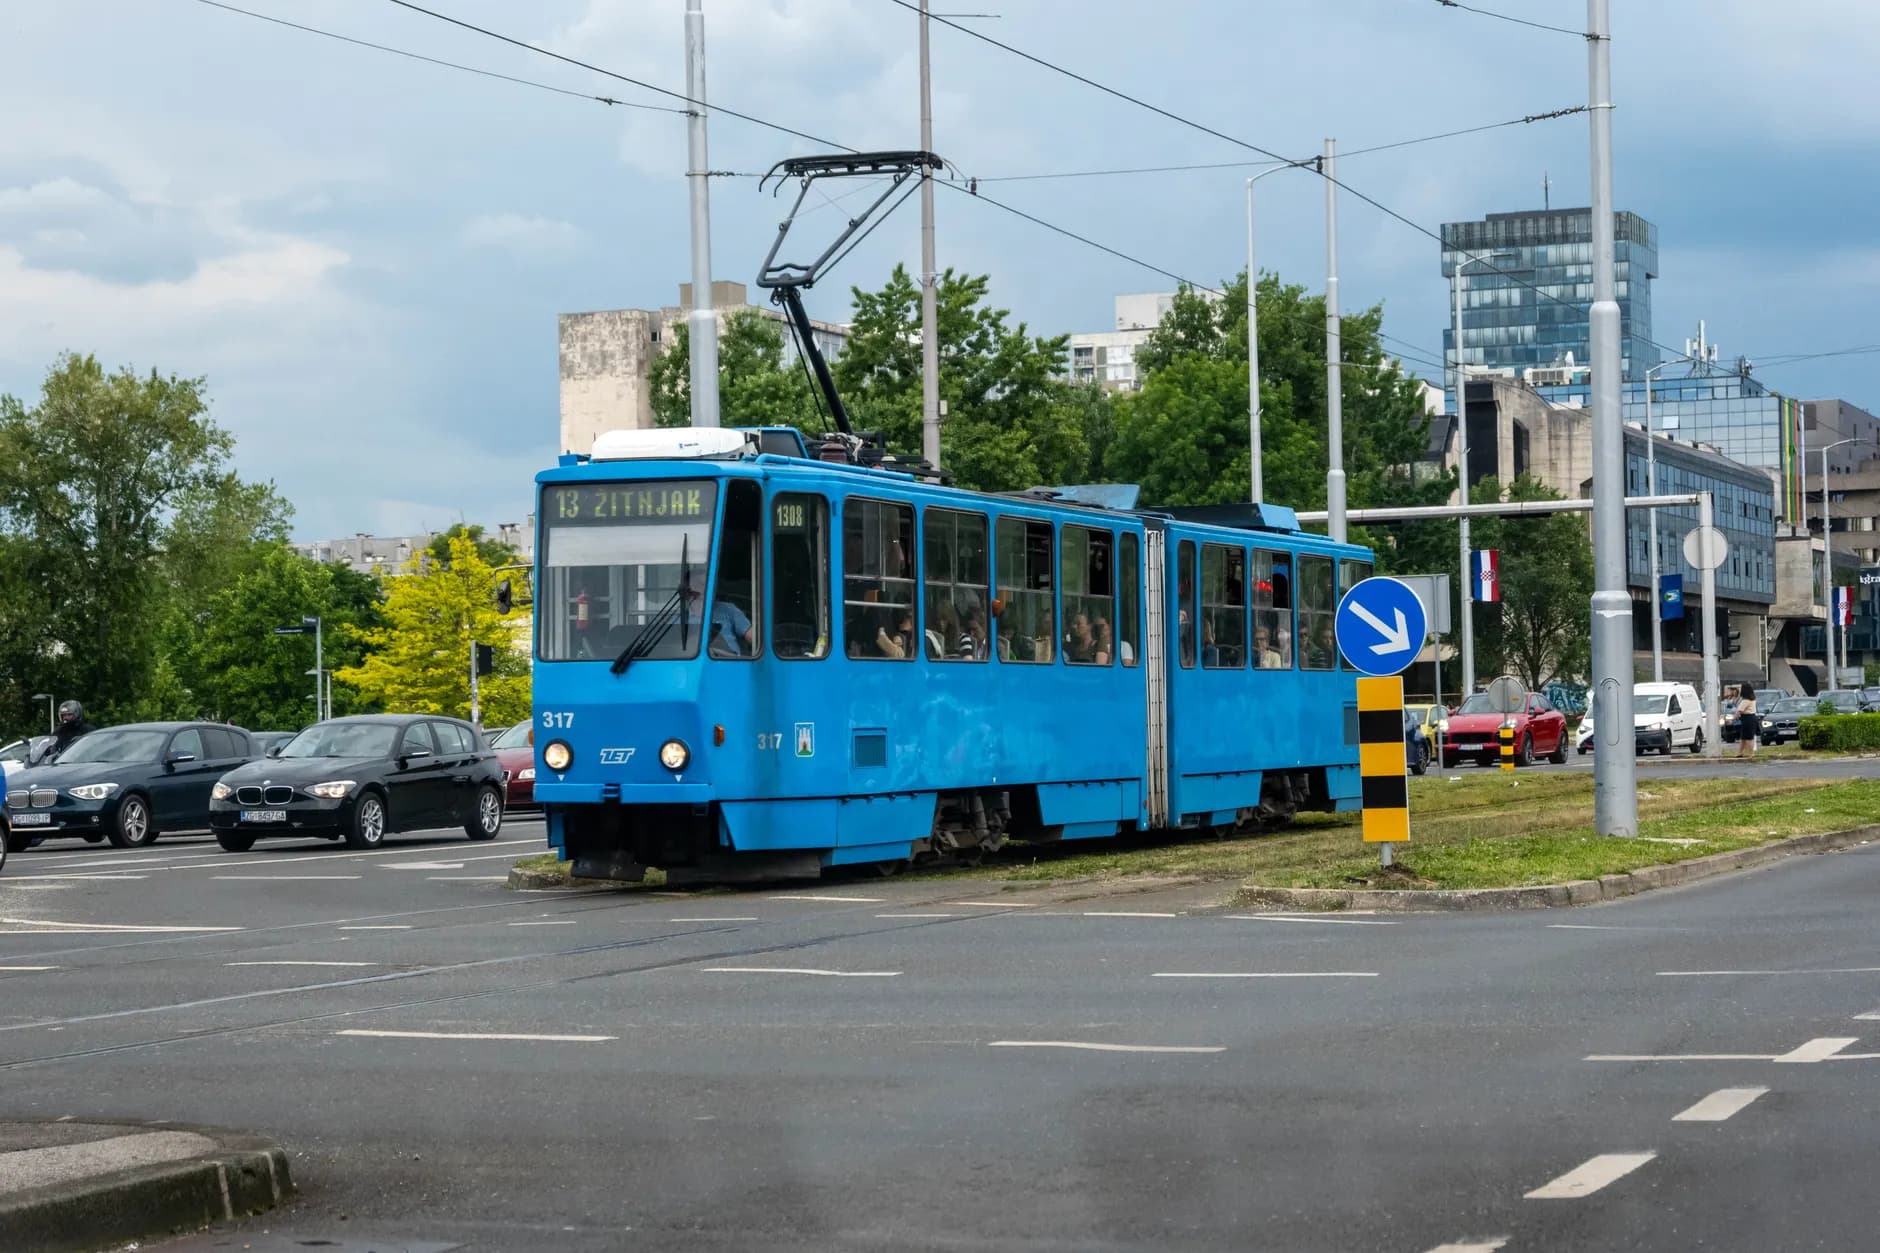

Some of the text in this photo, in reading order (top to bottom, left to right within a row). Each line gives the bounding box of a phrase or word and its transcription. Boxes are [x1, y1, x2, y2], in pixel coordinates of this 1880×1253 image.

[556, 490, 579, 518] 13
[776, 504, 802, 526] 1308
[542, 711, 574, 728] 317
[757, 733, 782, 749] 317
[600, 748, 635, 764] ZET
